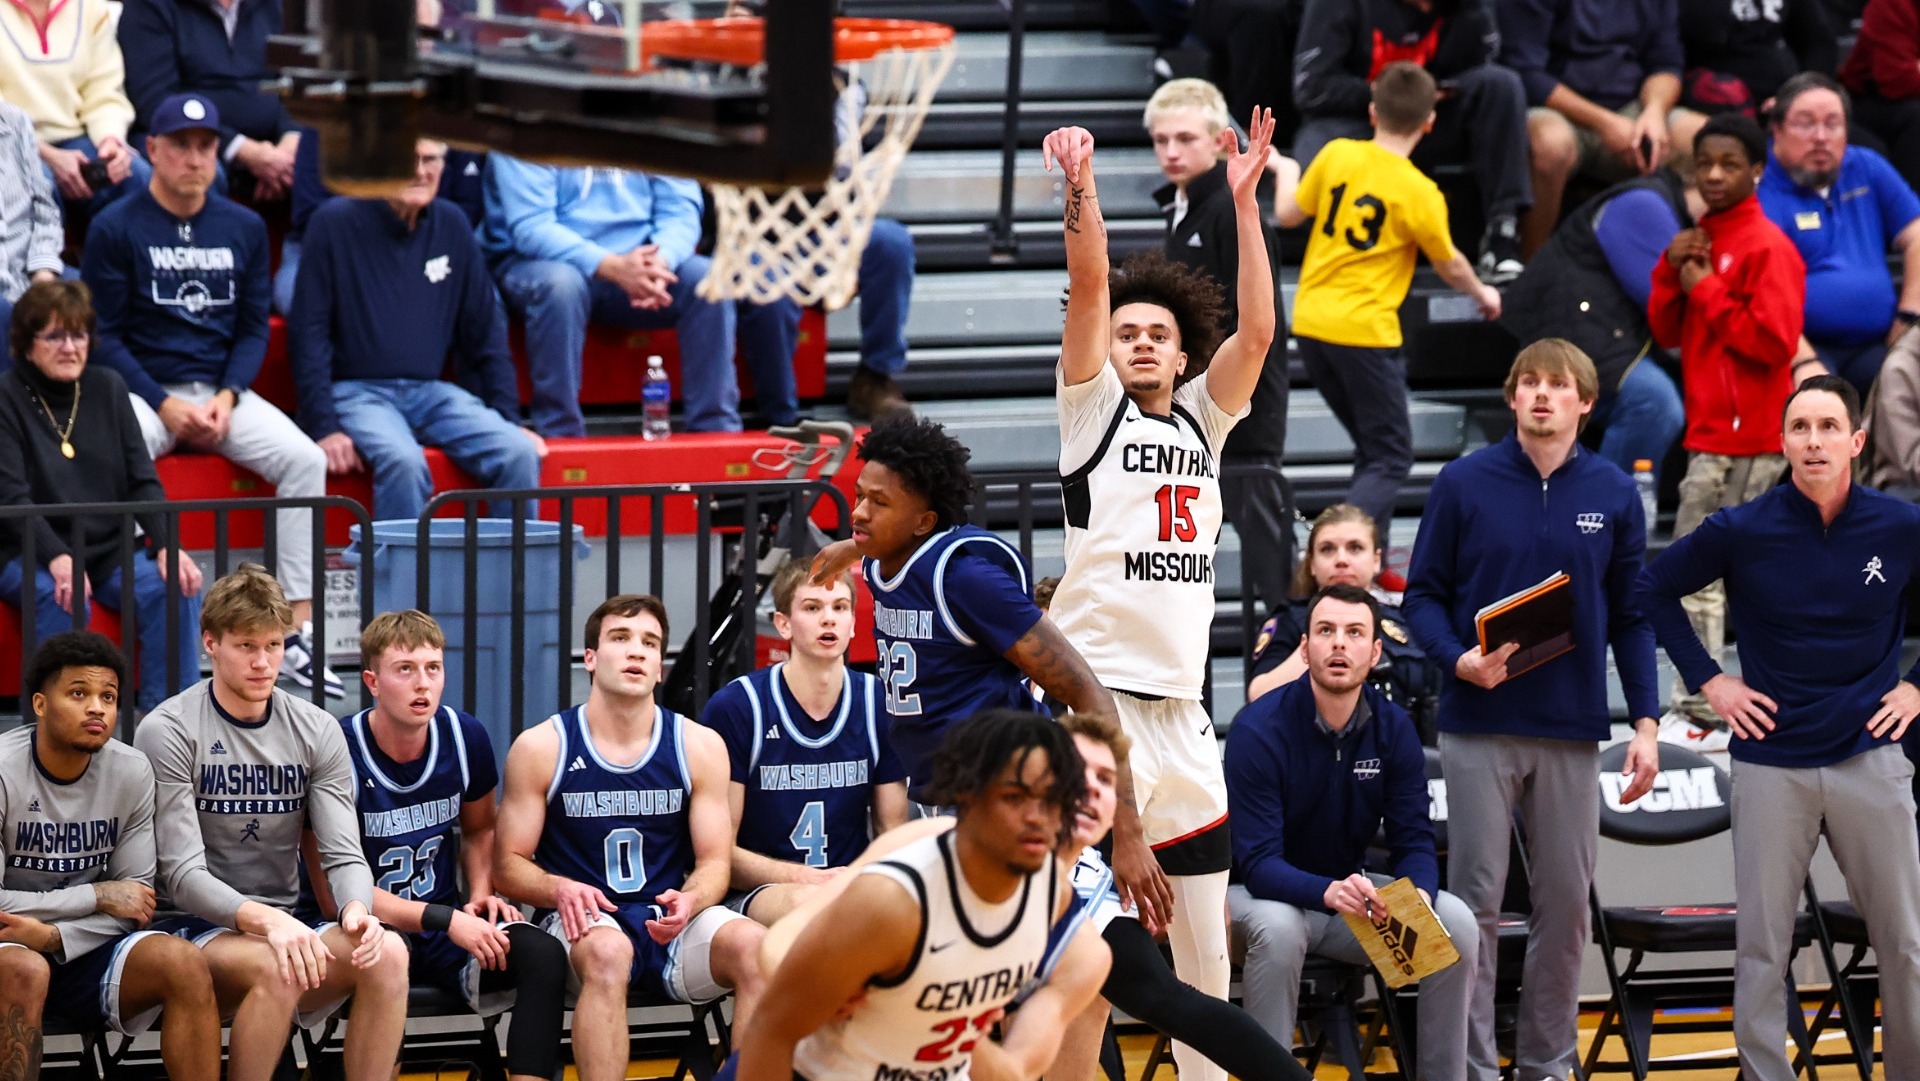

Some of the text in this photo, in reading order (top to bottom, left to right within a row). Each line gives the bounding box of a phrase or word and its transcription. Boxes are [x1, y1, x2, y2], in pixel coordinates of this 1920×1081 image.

[1067, 187, 1084, 234] FEAR
[1323, 182, 1387, 251] 13
[1123, 443, 1214, 478] CENTRAL
[1155, 484, 1200, 542] 15
[877, 639, 922, 715] 22
[200, 763, 307, 795] WASHBURN
[760, 759, 868, 790] WASHBURN
[1599, 766, 1725, 813] UCM
[199, 799, 301, 814] BASKETBALL
[363, 792, 461, 838] WASHBURN
[562, 788, 683, 818] WASHBURN
[15, 817, 119, 854] WASHBURN
[789, 801, 828, 868] 4
[14, 853, 109, 872] BASKETBALL
[377, 835, 444, 901] 23
[604, 827, 647, 894] 0
[1370, 914, 1416, 977] didas
[916, 961, 1034, 1012] CENTRA
